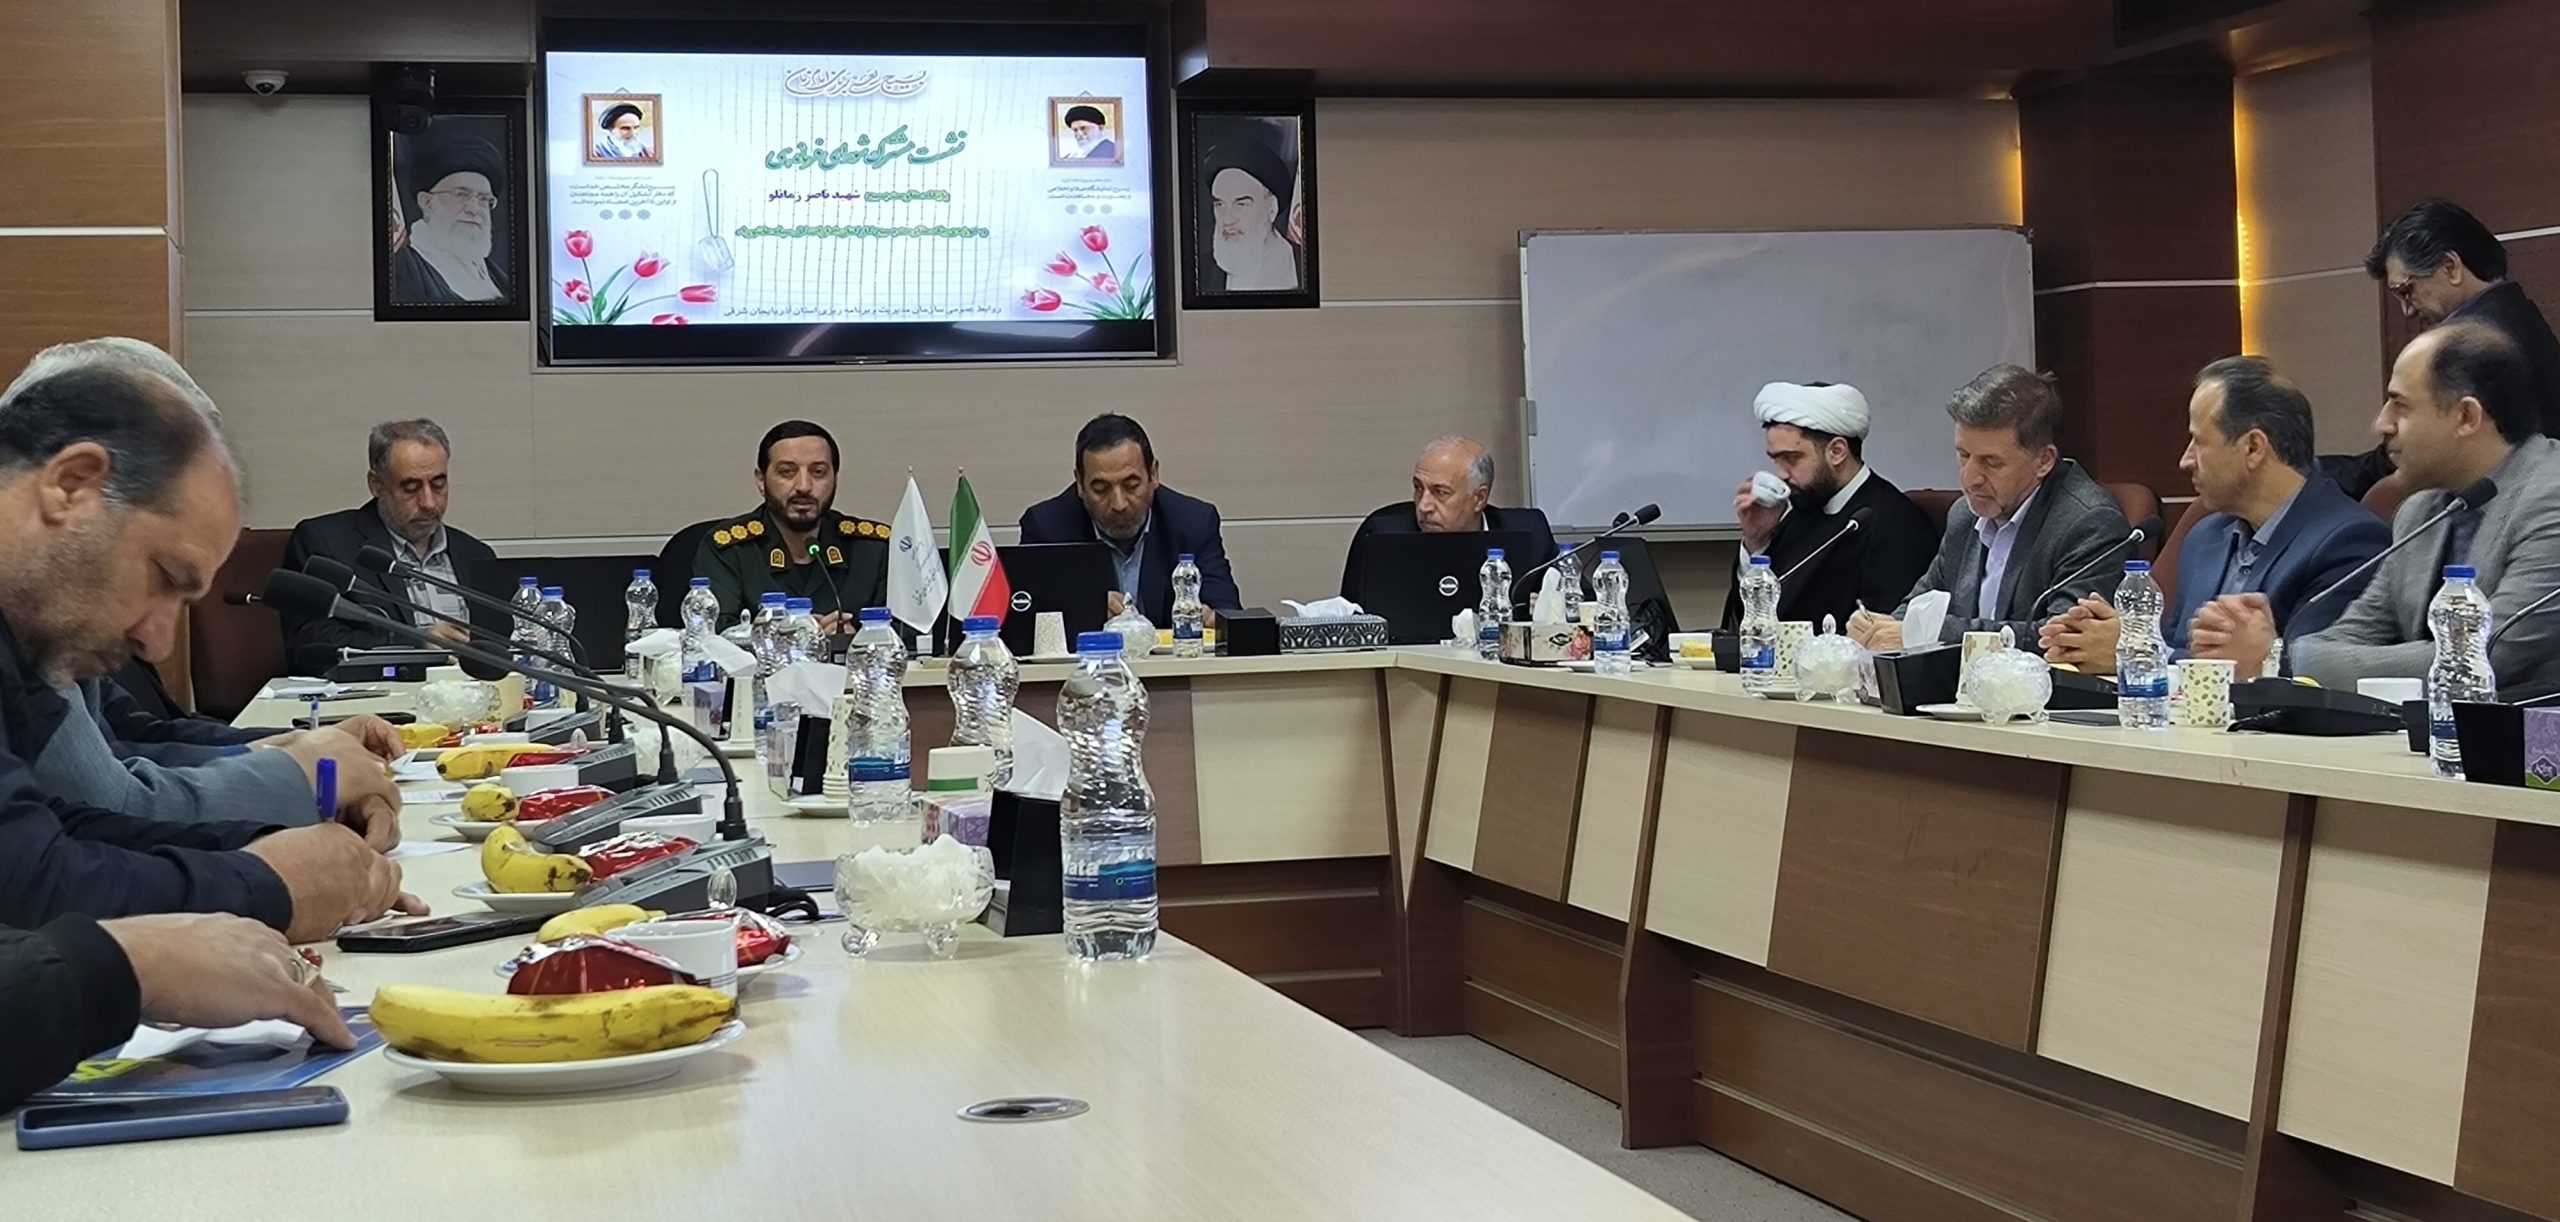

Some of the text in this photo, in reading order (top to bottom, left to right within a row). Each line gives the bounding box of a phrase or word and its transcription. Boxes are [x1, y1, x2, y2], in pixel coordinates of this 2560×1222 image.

[765, 124, 968, 171] نشست مشترک شورای فرماندهی
[768, 189, 802, 203] زمانلو
[806, 189, 830, 202] ناصر
[832, 189, 860, 201] شهید
[723, 306, 748, 317] شرقی
[792, 306, 818, 316] استان
[844, 306, 870, 316] برنامه
[878, 305, 910, 315] مدیریت
[911, 304, 945, 315] سازمان
[947, 306, 975, 315] عمومی
[977, 304, 1003, 314] روابط
